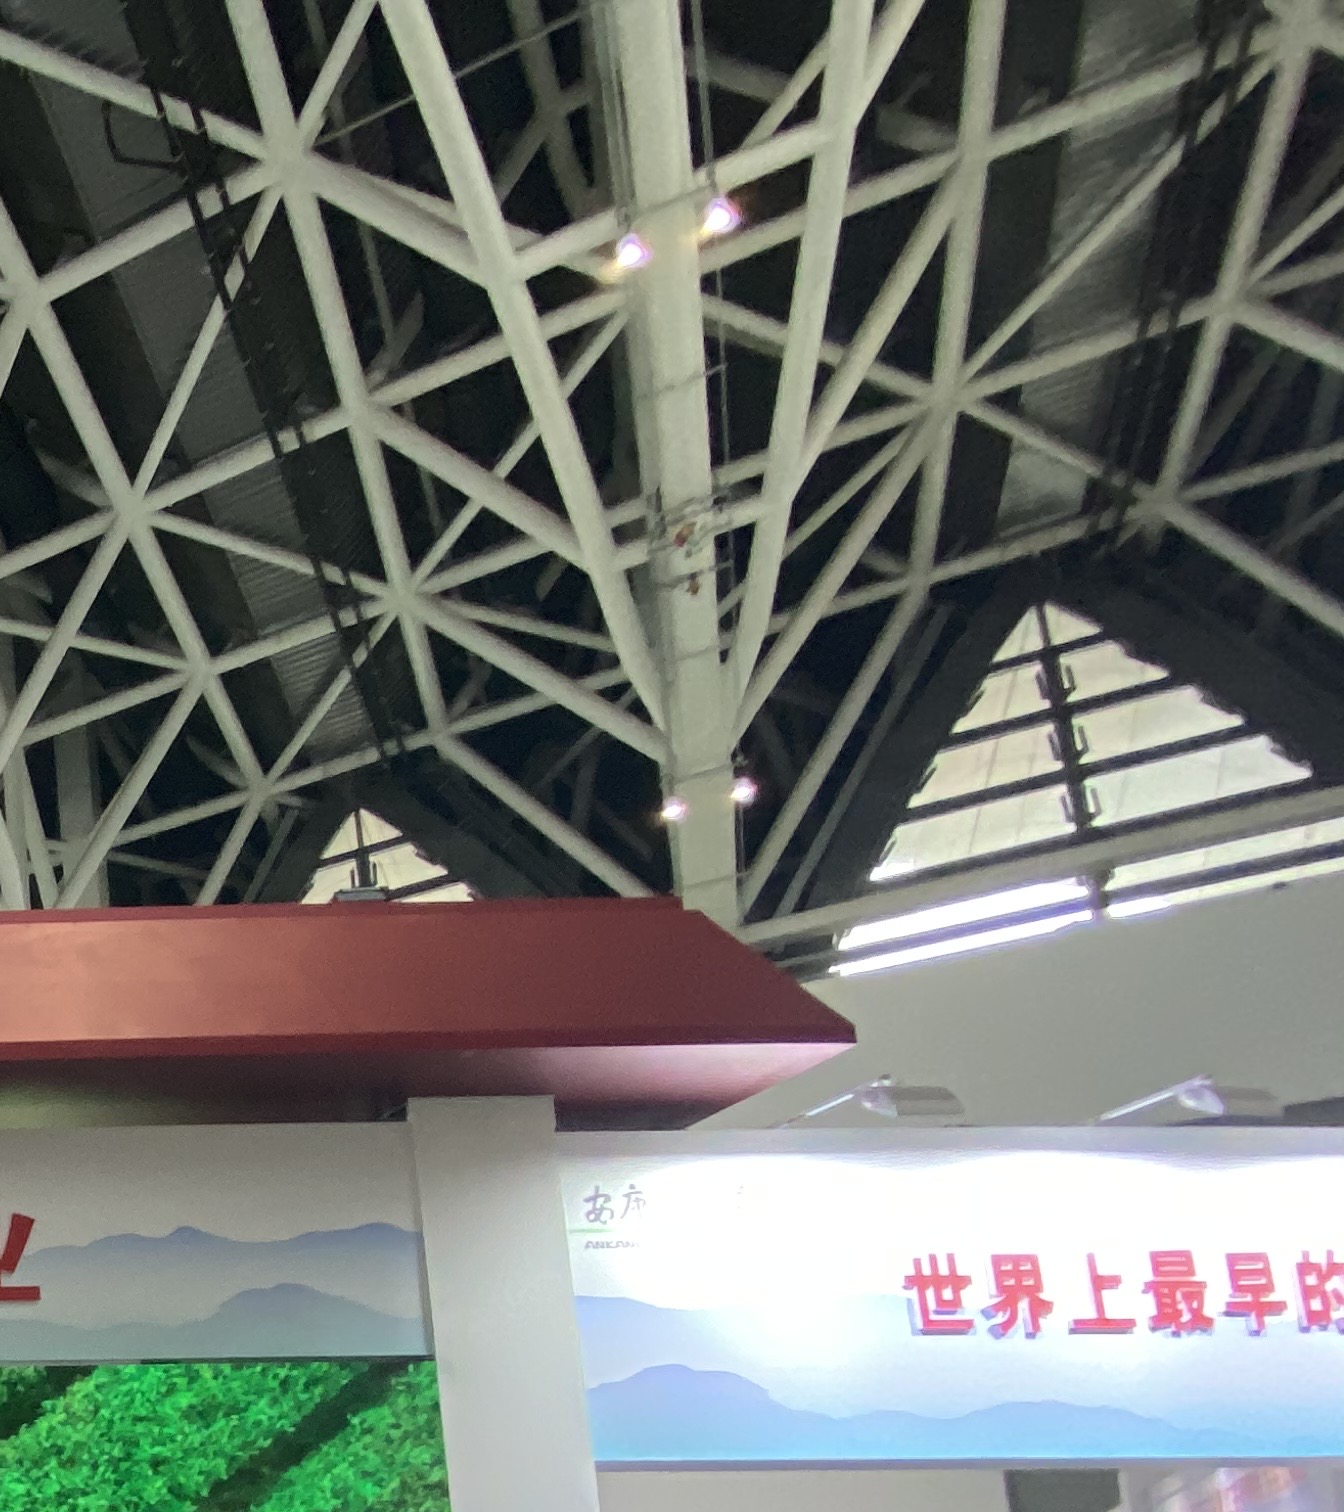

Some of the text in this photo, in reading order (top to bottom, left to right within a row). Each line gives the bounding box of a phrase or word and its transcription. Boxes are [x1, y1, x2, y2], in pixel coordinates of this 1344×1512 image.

[902, 1250, 1344, 1338] 世界上最早的
